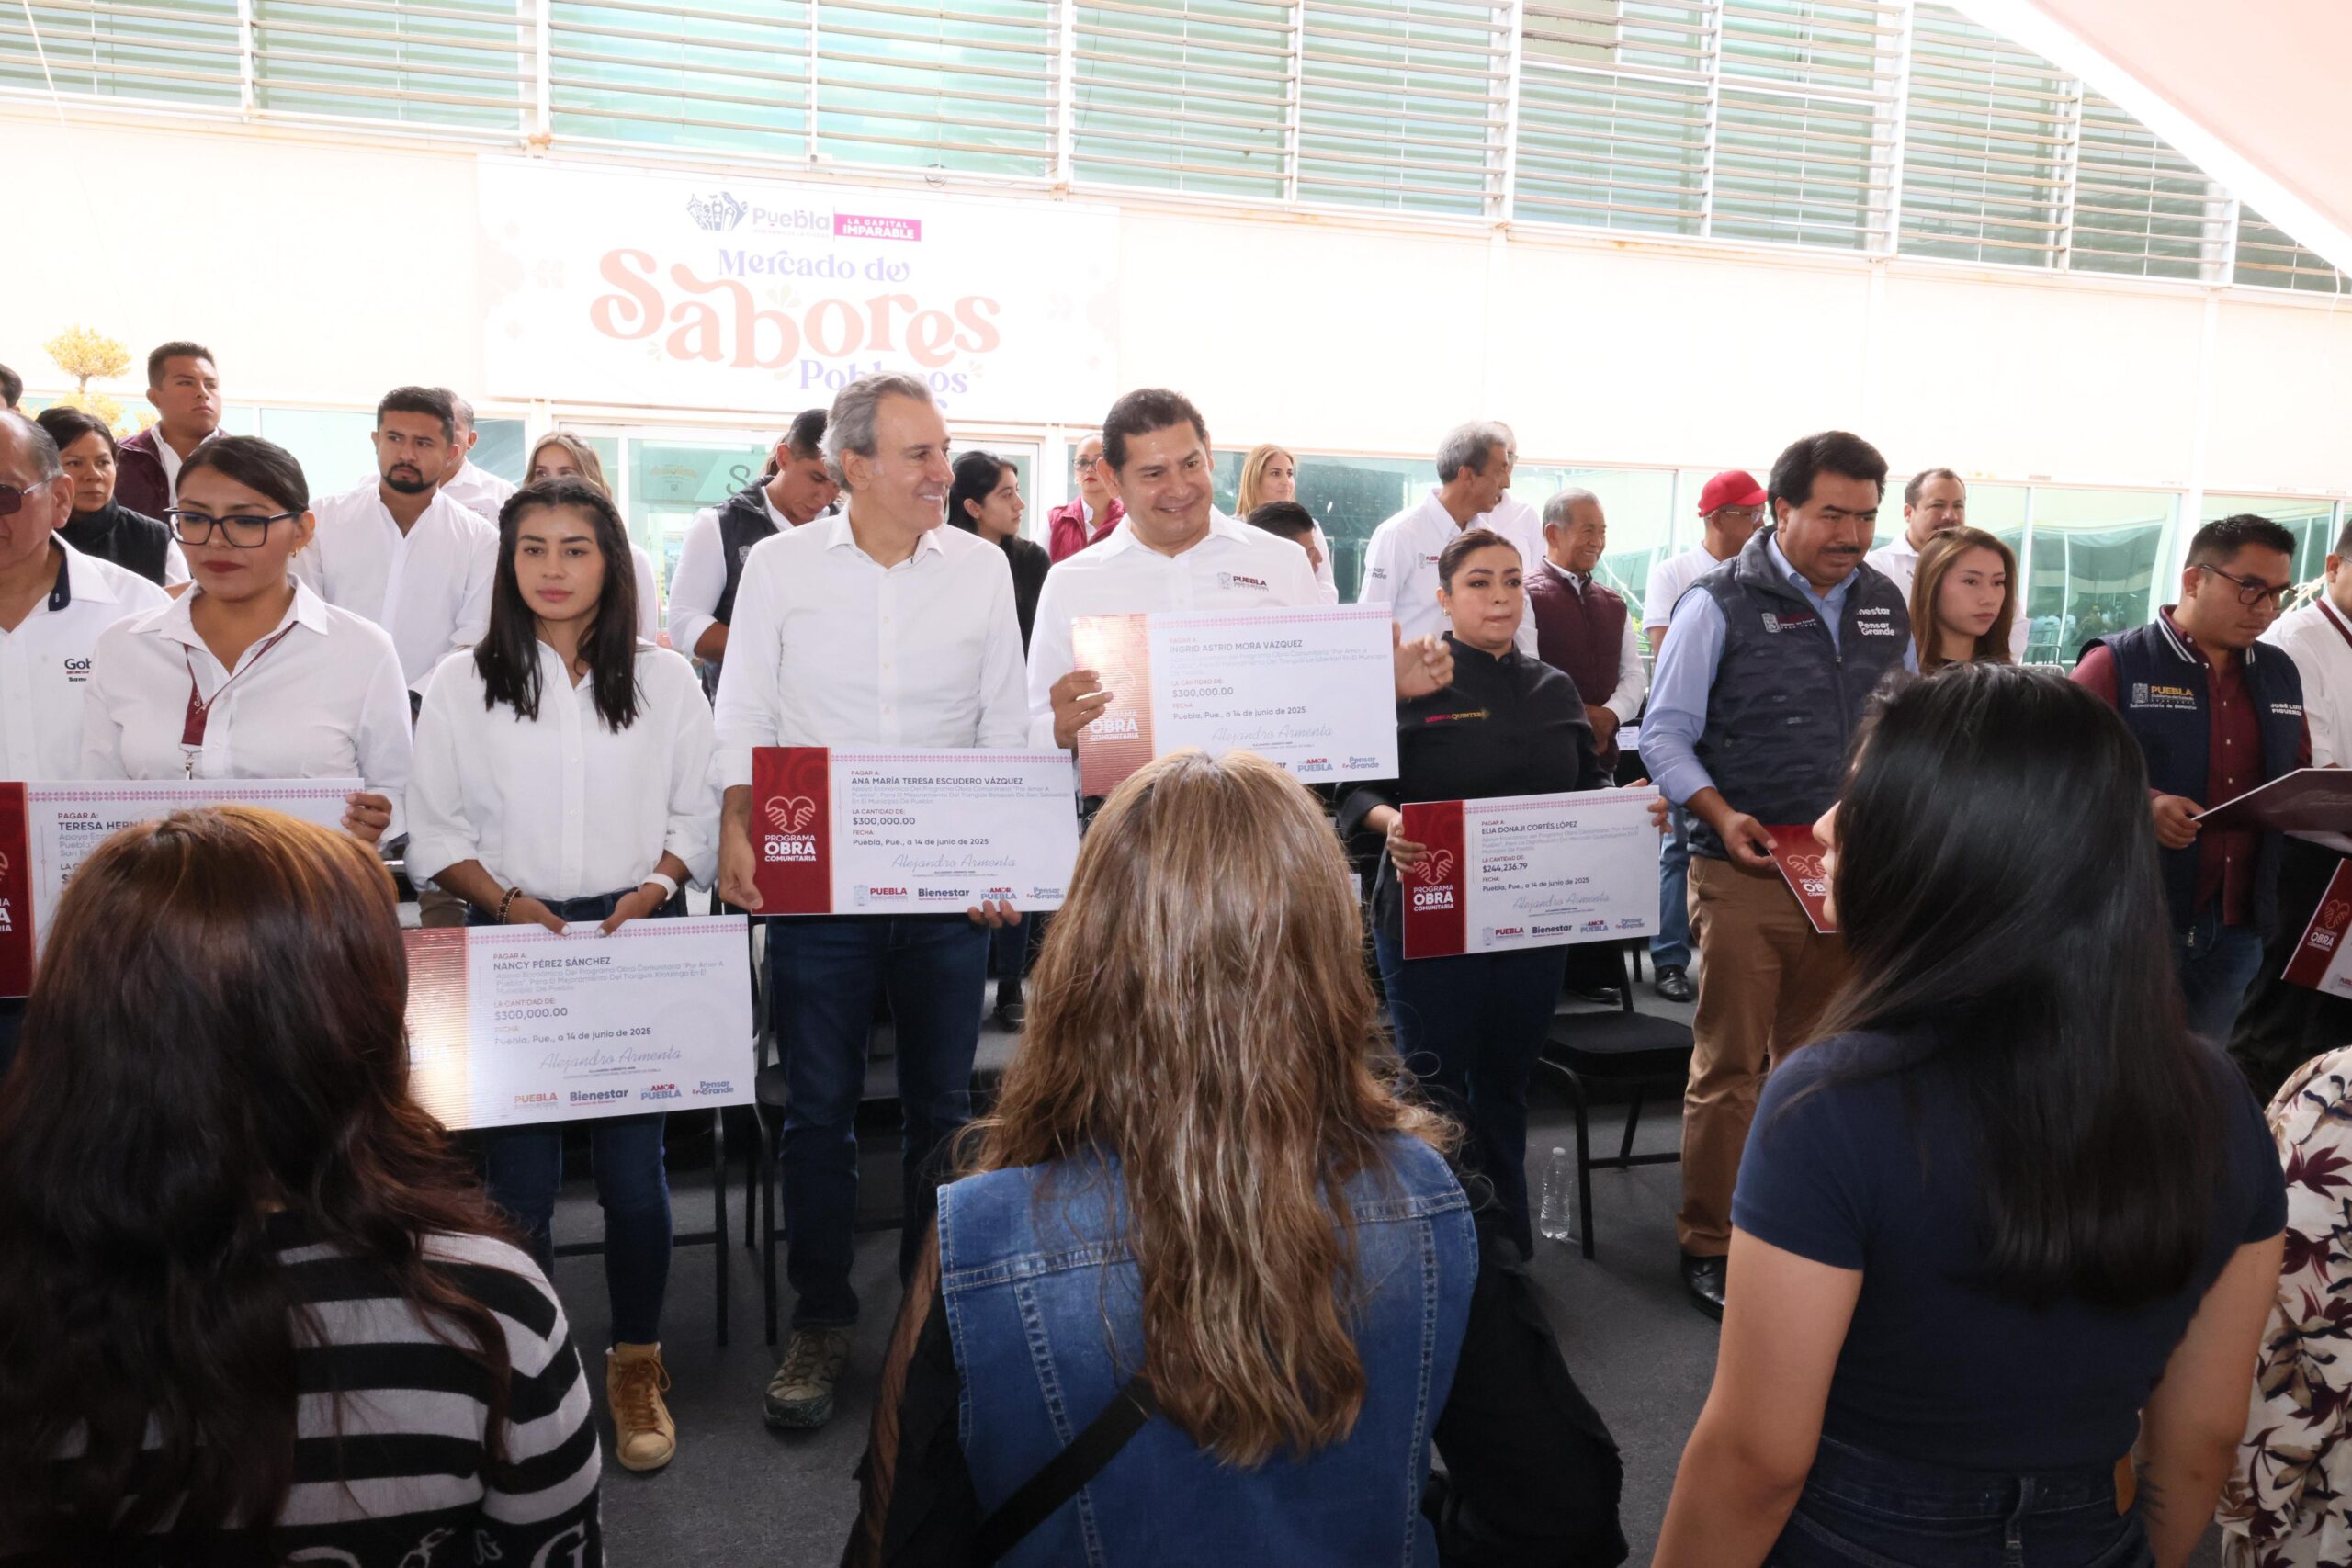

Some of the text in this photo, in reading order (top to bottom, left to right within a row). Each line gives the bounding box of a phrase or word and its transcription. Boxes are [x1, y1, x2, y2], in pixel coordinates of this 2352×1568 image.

[752, 207, 831, 231] Puebla
[847, 218, 908, 229] LA CAPITAL
[842, 224, 915, 239] IMPARABLE
[718, 248, 910, 282] Mercado de
[589, 248, 1001, 368] Sabores
[1233, 576, 1267, 587] PUEBLA
[1858, 620, 1891, 629] Pensar
[1863, 626, 1895, 636] Grande
[1170, 639, 1303, 654] INGRID ASTRID MORA VÁZQUEZ
[1172, 686, 1234, 699] $300,000.00
[2151, 685, 2194, 696] PUEBLA
[1255, 708, 1273, 718] junio
[1287, 706, 1306, 715] 2025
[1091, 719, 1139, 734] OBRA
[1297, 763, 1334, 773] PUEBLA
[873, 776, 900, 784] MARÍA
[984, 777, 1023, 785] VÁZQUEZ
[57, 812, 99, 820] PAGAR A:
[58, 821, 103, 831] TERESA
[853, 817, 916, 827] $300,000.00
[1482, 827, 1497, 835] ELIA
[1527, 822, 1555, 831] CORTÉS
[1555, 820, 1577, 829] LÓPEZ
[59, 832, 88, 841] Apoyo
[764, 834, 816, 842] PROGRAMA
[764, 841, 816, 855] OBRA
[853, 839, 883, 848] Puebla,
[885, 839, 905, 847] Pue.,
[937, 838, 956, 847] junio
[60, 849, 77, 857] San
[60, 863, 72, 871] LA
[1482, 863, 1528, 874] $244,236.79
[869, 887, 908, 896] PUEBLA
[1033, 886, 1061, 895] Pensar
[1413, 884, 1453, 893] PROGRAMA
[1482, 885, 1507, 893] Puebla,
[1548, 879, 1564, 888] junio
[918, 888, 970, 897] Bienestar
[1413, 892, 1453, 906] OBRA
[1495, 927, 1524, 935] PUEBLA
[1532, 924, 1573, 934] Bienestar
[1580, 925, 1609, 933] PUEBLA
[2311, 931, 2335, 948] OBRA
[493, 956, 611, 971] NANCY PÉREZ SÁNCHEZ
[494, 1007, 568, 1021] $300,000.00
[578, 1032, 589, 1040] de
[592, 1030, 614, 1041] junio
[616, 1029, 628, 1037] de
[629, 1027, 651, 1036] 2025
[699, 1080, 730, 1089] Pensar
[514, 1092, 558, 1103] PUEBLA
[569, 1089, 628, 1102] Bienestar
[640, 1089, 682, 1100] PUEBLA
